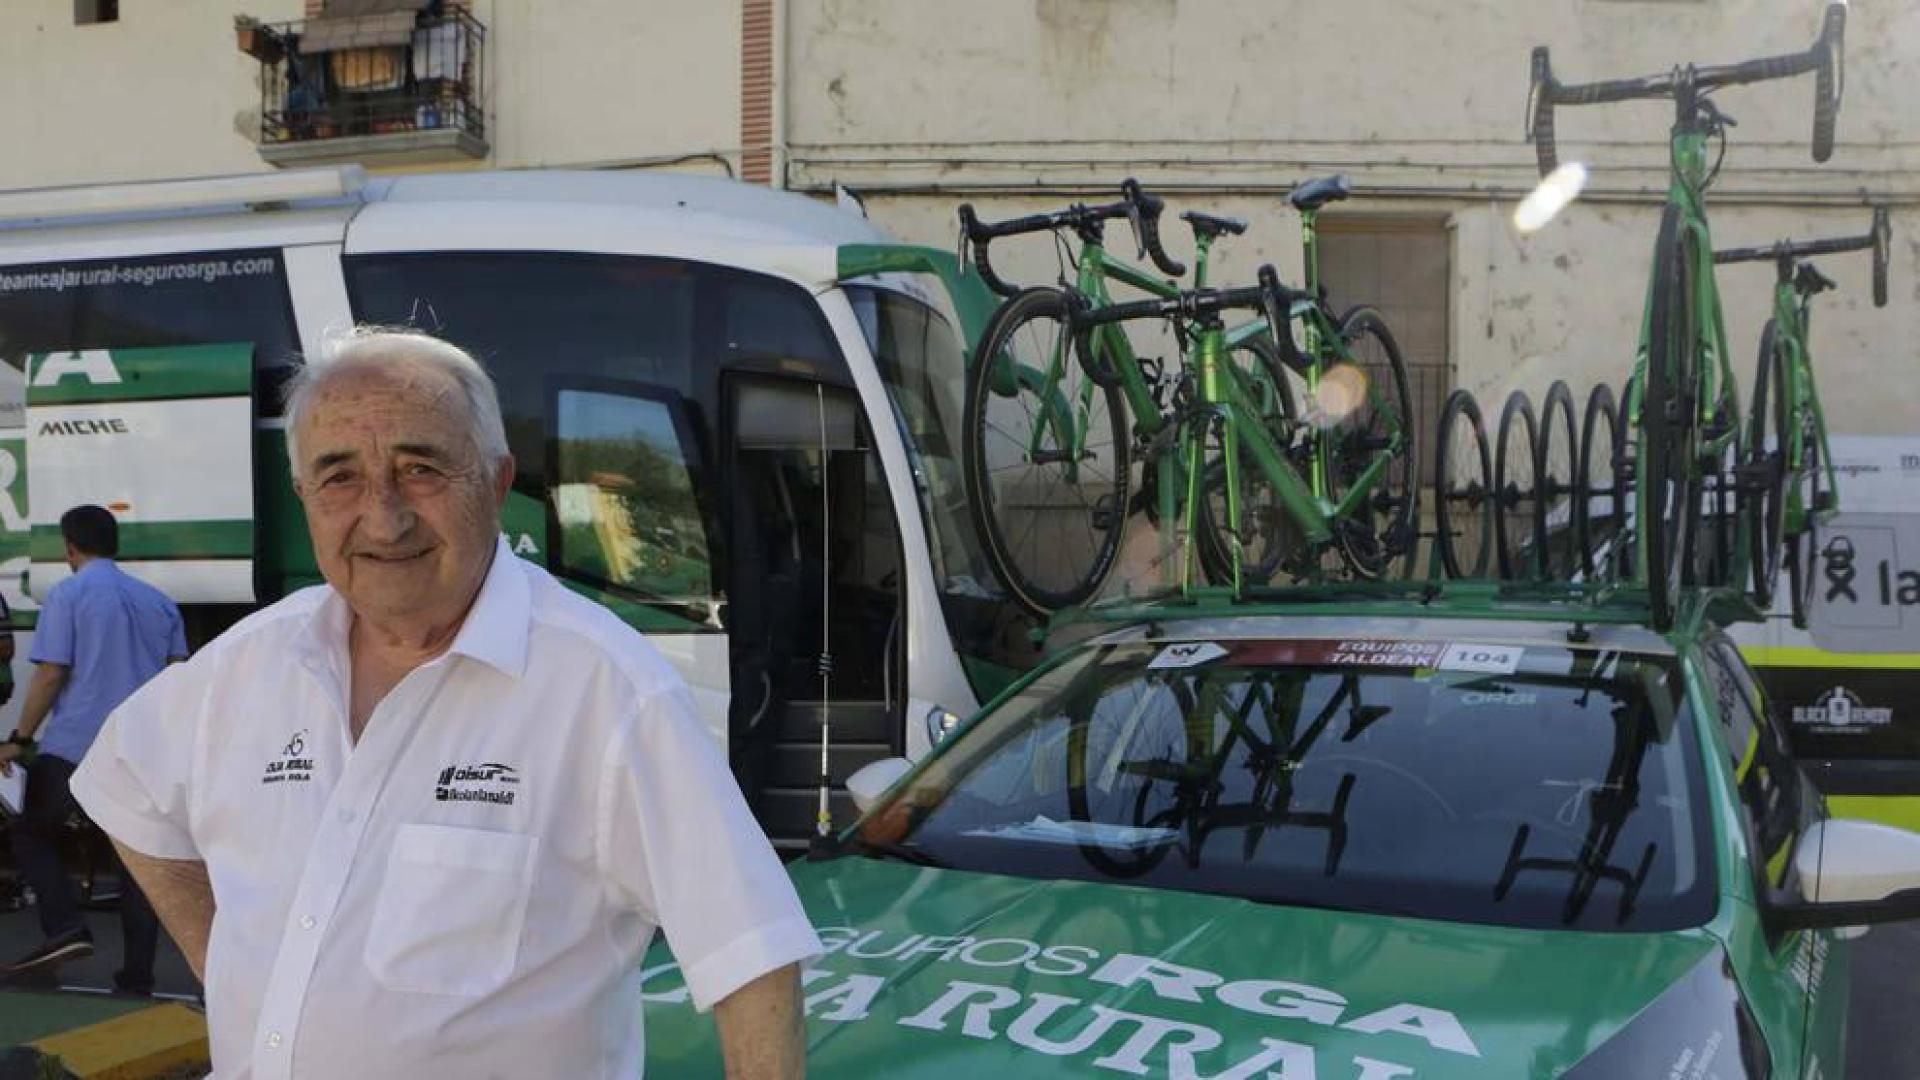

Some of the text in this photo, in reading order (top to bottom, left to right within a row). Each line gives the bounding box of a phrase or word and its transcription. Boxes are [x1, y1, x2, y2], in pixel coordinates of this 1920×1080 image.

[39, 418, 129, 436] MICHE
[1337, 641, 1439, 653] EQUIPOS
[1326, 652, 1436, 666] TALDEAK
[1458, 651, 1510, 665] 104
[1088, 953, 1482, 1057] RGA
